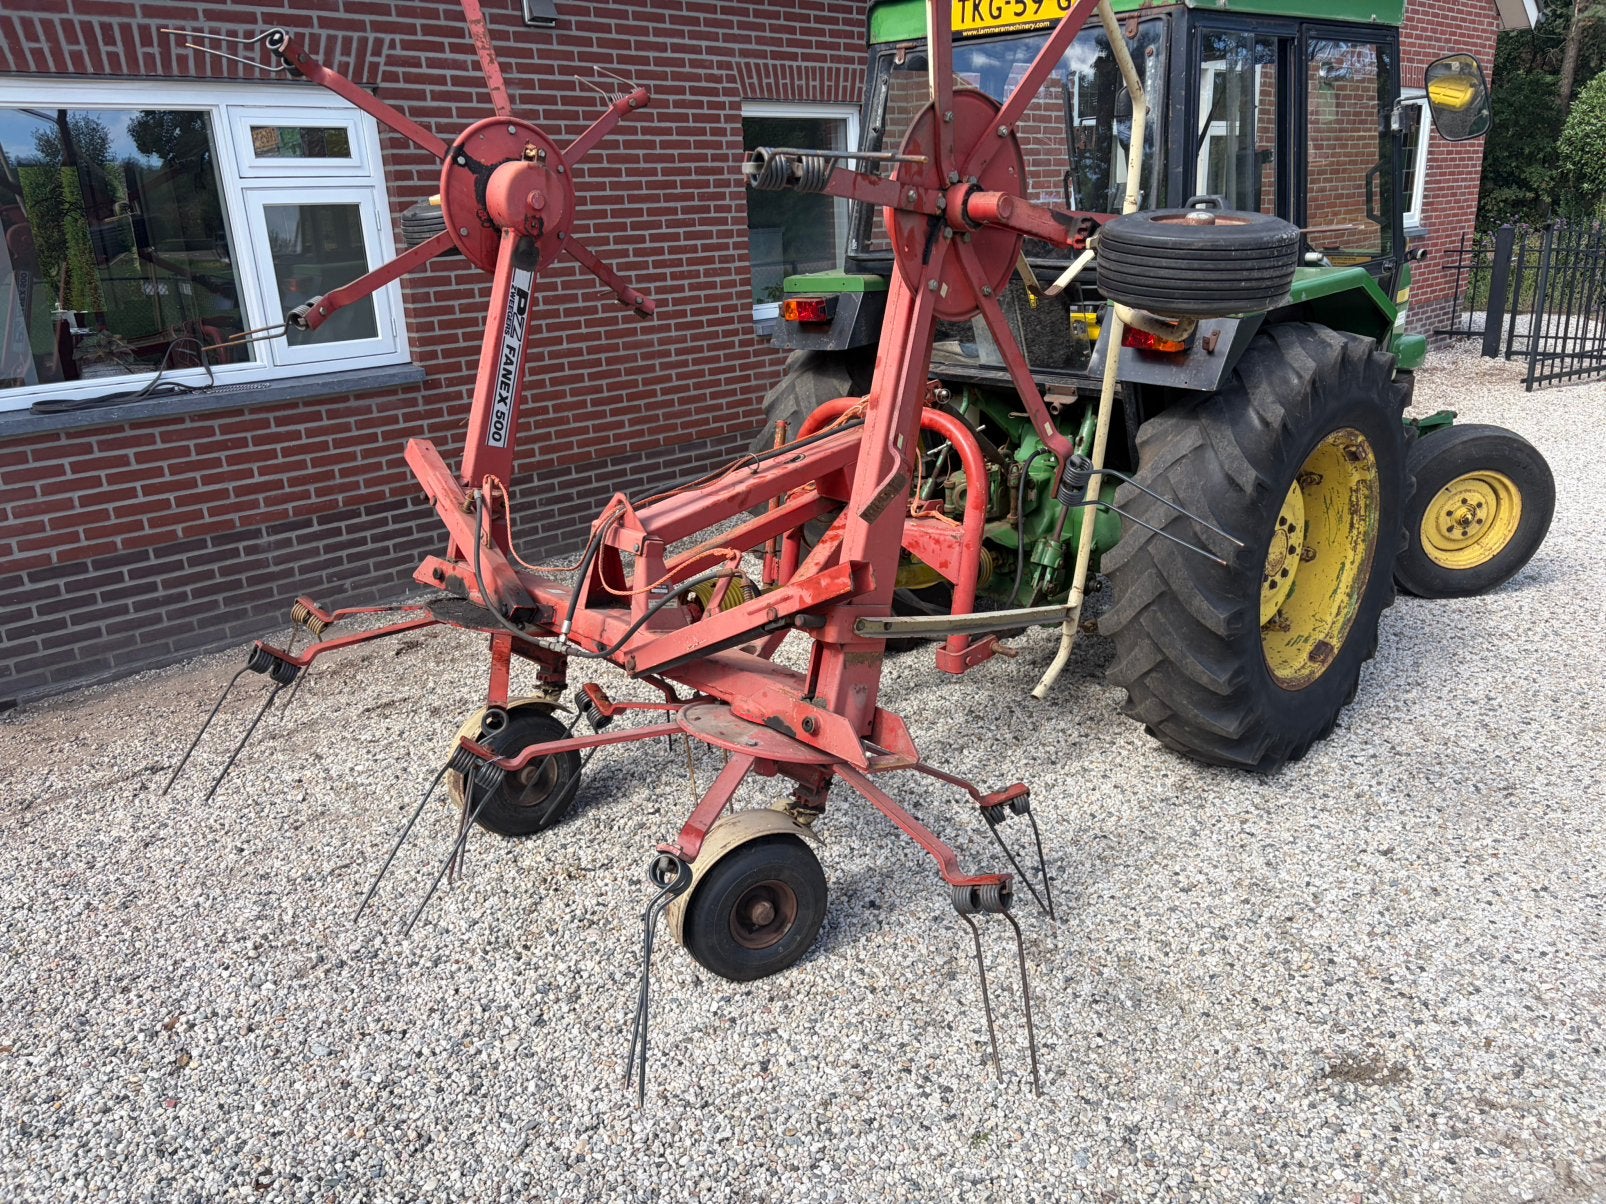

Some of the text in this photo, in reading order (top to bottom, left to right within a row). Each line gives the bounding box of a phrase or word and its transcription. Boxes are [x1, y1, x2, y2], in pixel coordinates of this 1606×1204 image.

[505, 284, 518, 336] ZWEEGERS
[492, 287, 529, 442] PZ FANEX 500
